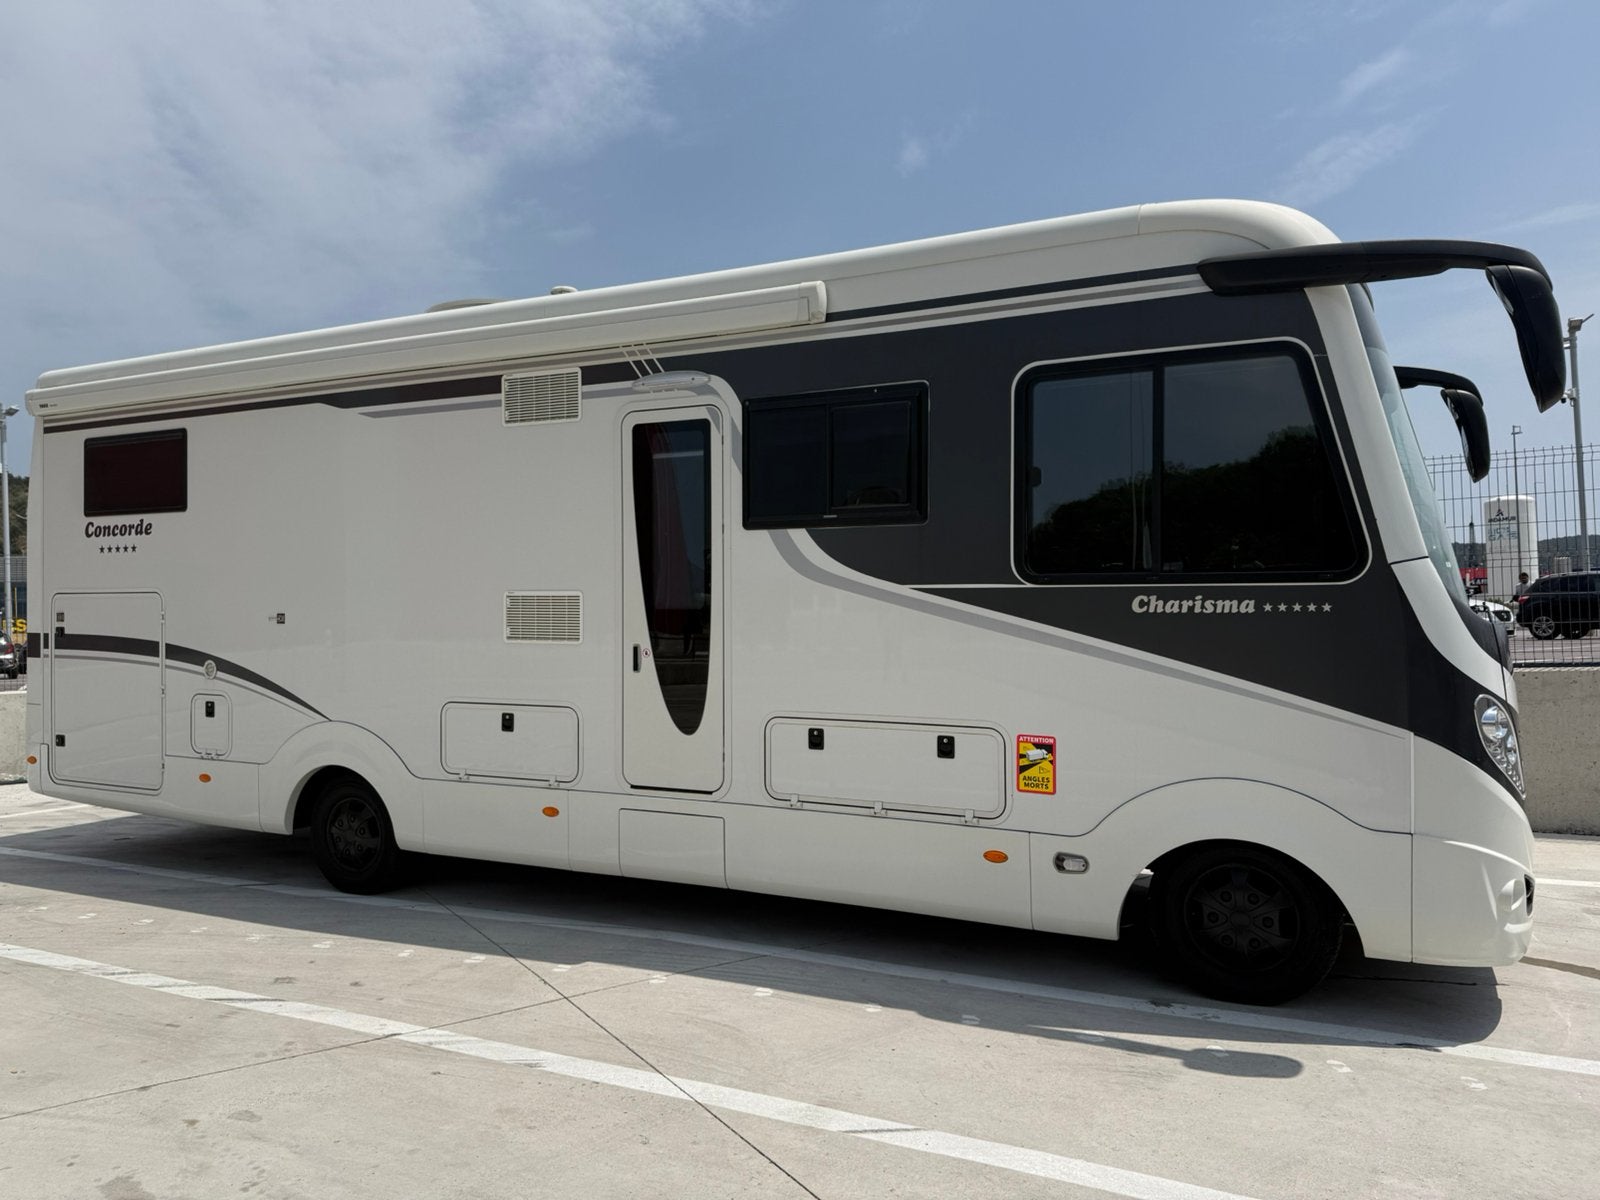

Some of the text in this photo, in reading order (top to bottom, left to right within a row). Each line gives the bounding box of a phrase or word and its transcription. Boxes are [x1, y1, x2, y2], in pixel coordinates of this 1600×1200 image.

[85, 518, 152, 538] Concorde
[1131, 595, 1255, 614] Charisma
[1019, 736, 1054, 744] ATTENTION
[1022, 775, 1050, 783] ANGLES
[1023, 782, 1049, 790] MORTS
